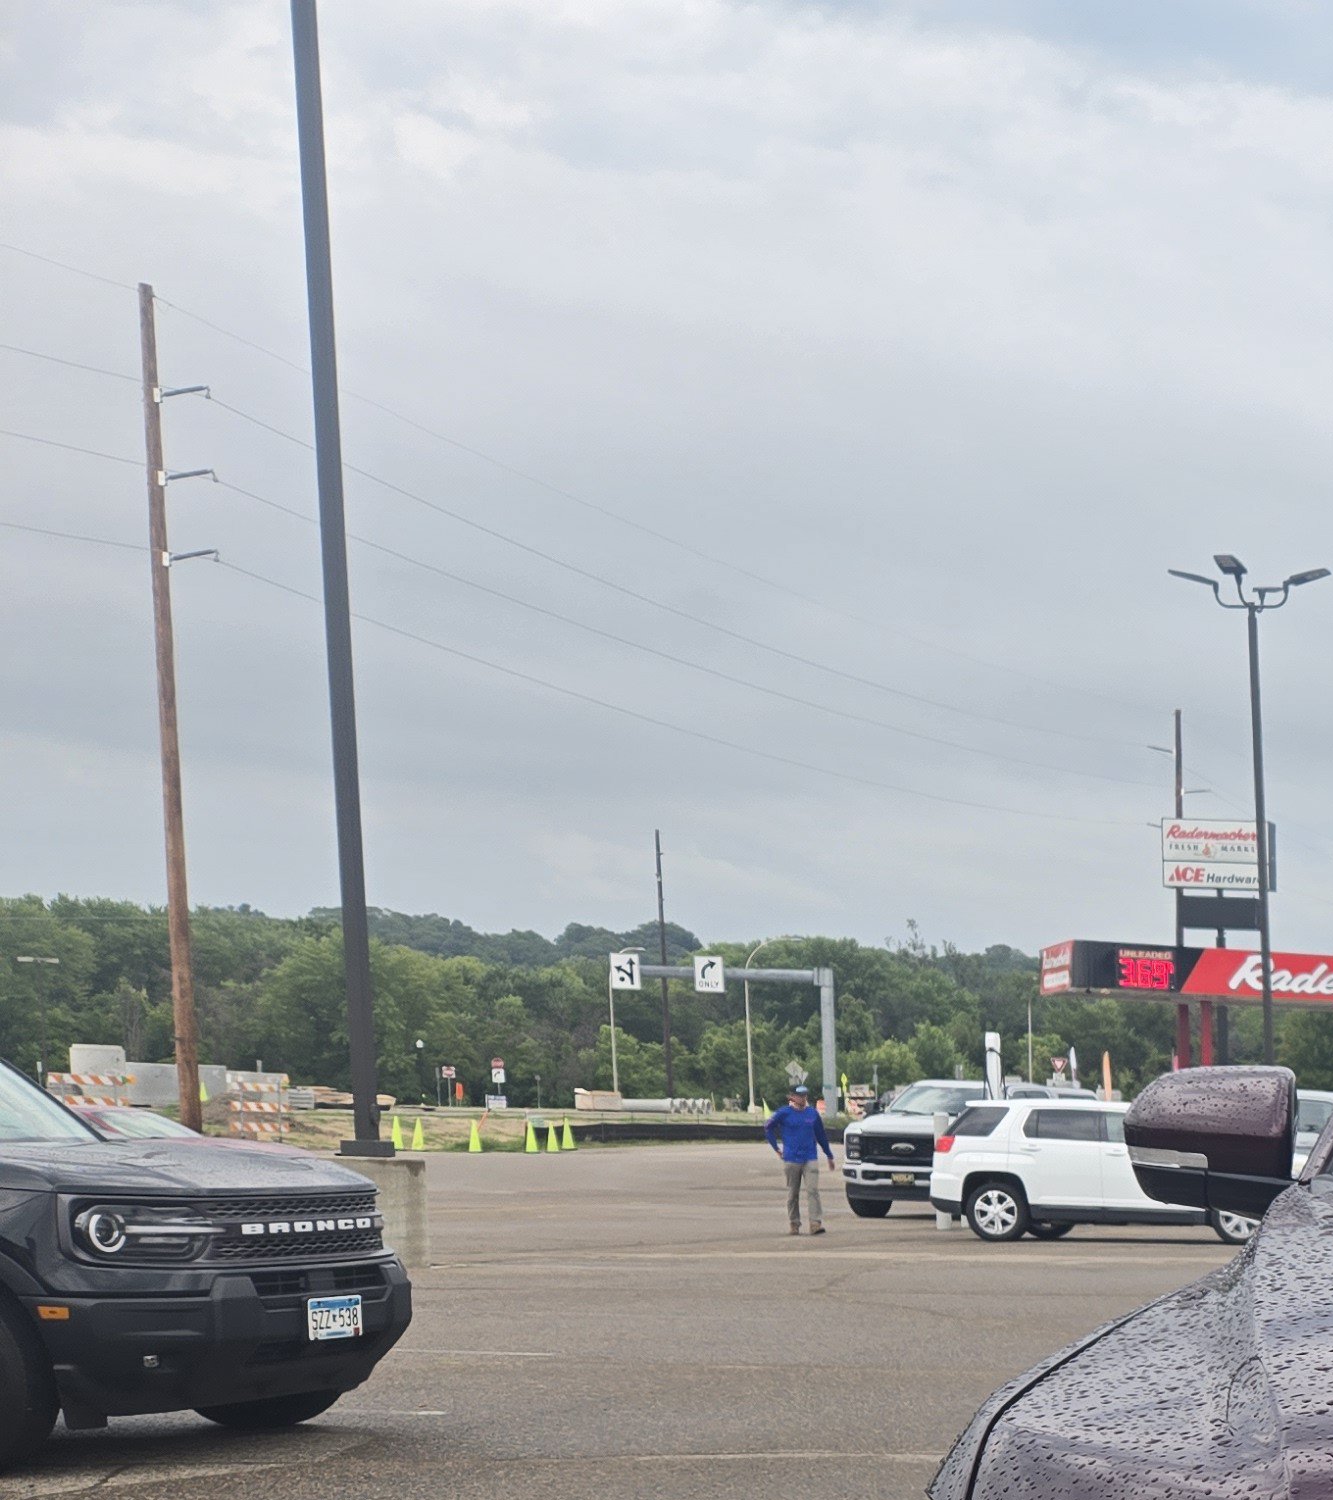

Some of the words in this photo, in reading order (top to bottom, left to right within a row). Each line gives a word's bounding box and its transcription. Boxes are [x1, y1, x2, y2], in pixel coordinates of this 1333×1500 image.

[1169, 843, 1199, 851] FRESH
[1220, 844, 1256, 853] MARKE
[1168, 864, 1206, 883] ACE
[1206, 872, 1260, 885] Hardwar
[1118, 949, 1172, 960] UNLEADED
[698, 980, 719, 989] ONLY
[241, 1217, 371, 1235] BRONCO
